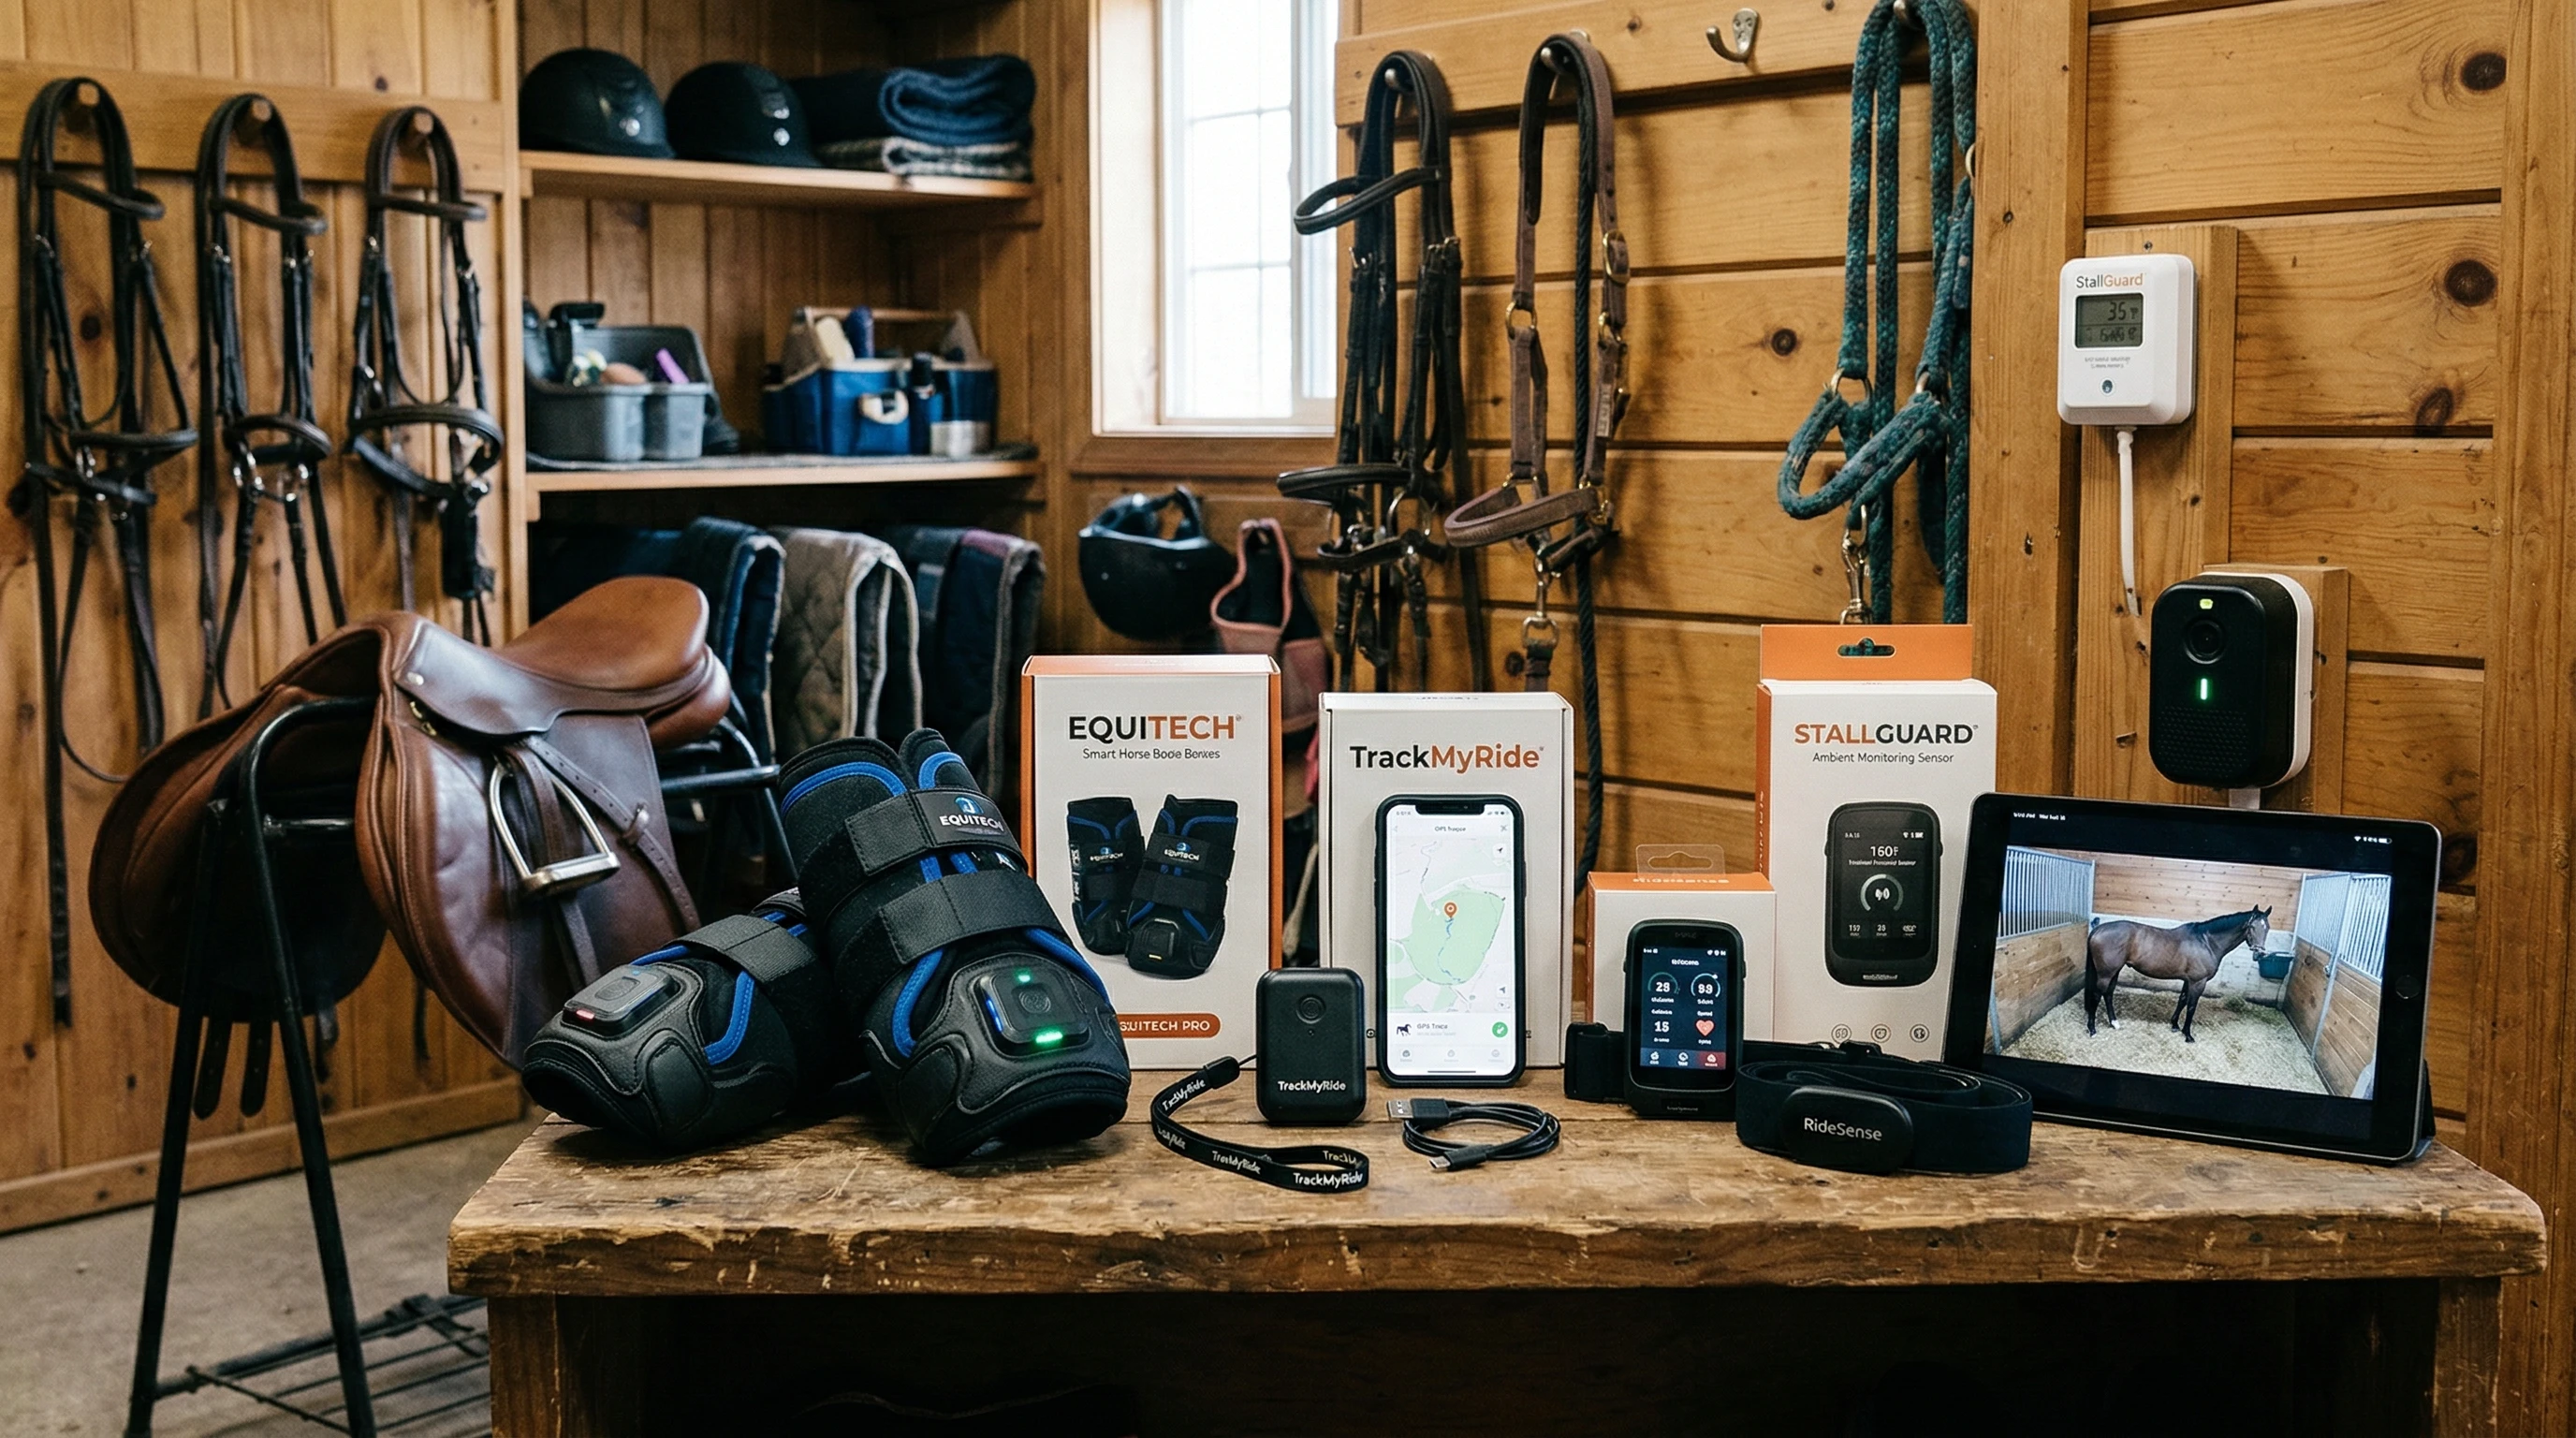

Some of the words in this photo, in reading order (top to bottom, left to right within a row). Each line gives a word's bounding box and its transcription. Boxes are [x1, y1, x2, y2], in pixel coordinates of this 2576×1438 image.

[2075, 273, 2144, 288] StallGuard
[1069, 715, 1235, 744] EQUITECH
[1794, 724, 1973, 744] STALLGUARD
[1083, 748, 1116, 759] Smart
[1120, 748, 1150, 759] Horse
[1350, 743, 1540, 774] TrackMyRide
[1813, 752, 1854, 763] Ambient
[1858, 752, 1915, 765] Monitoring
[1918, 752, 1954, 763] Sensor
[1182, 1020, 1210, 1031] PRO
[1803, 1117, 1883, 1141] RideSense
